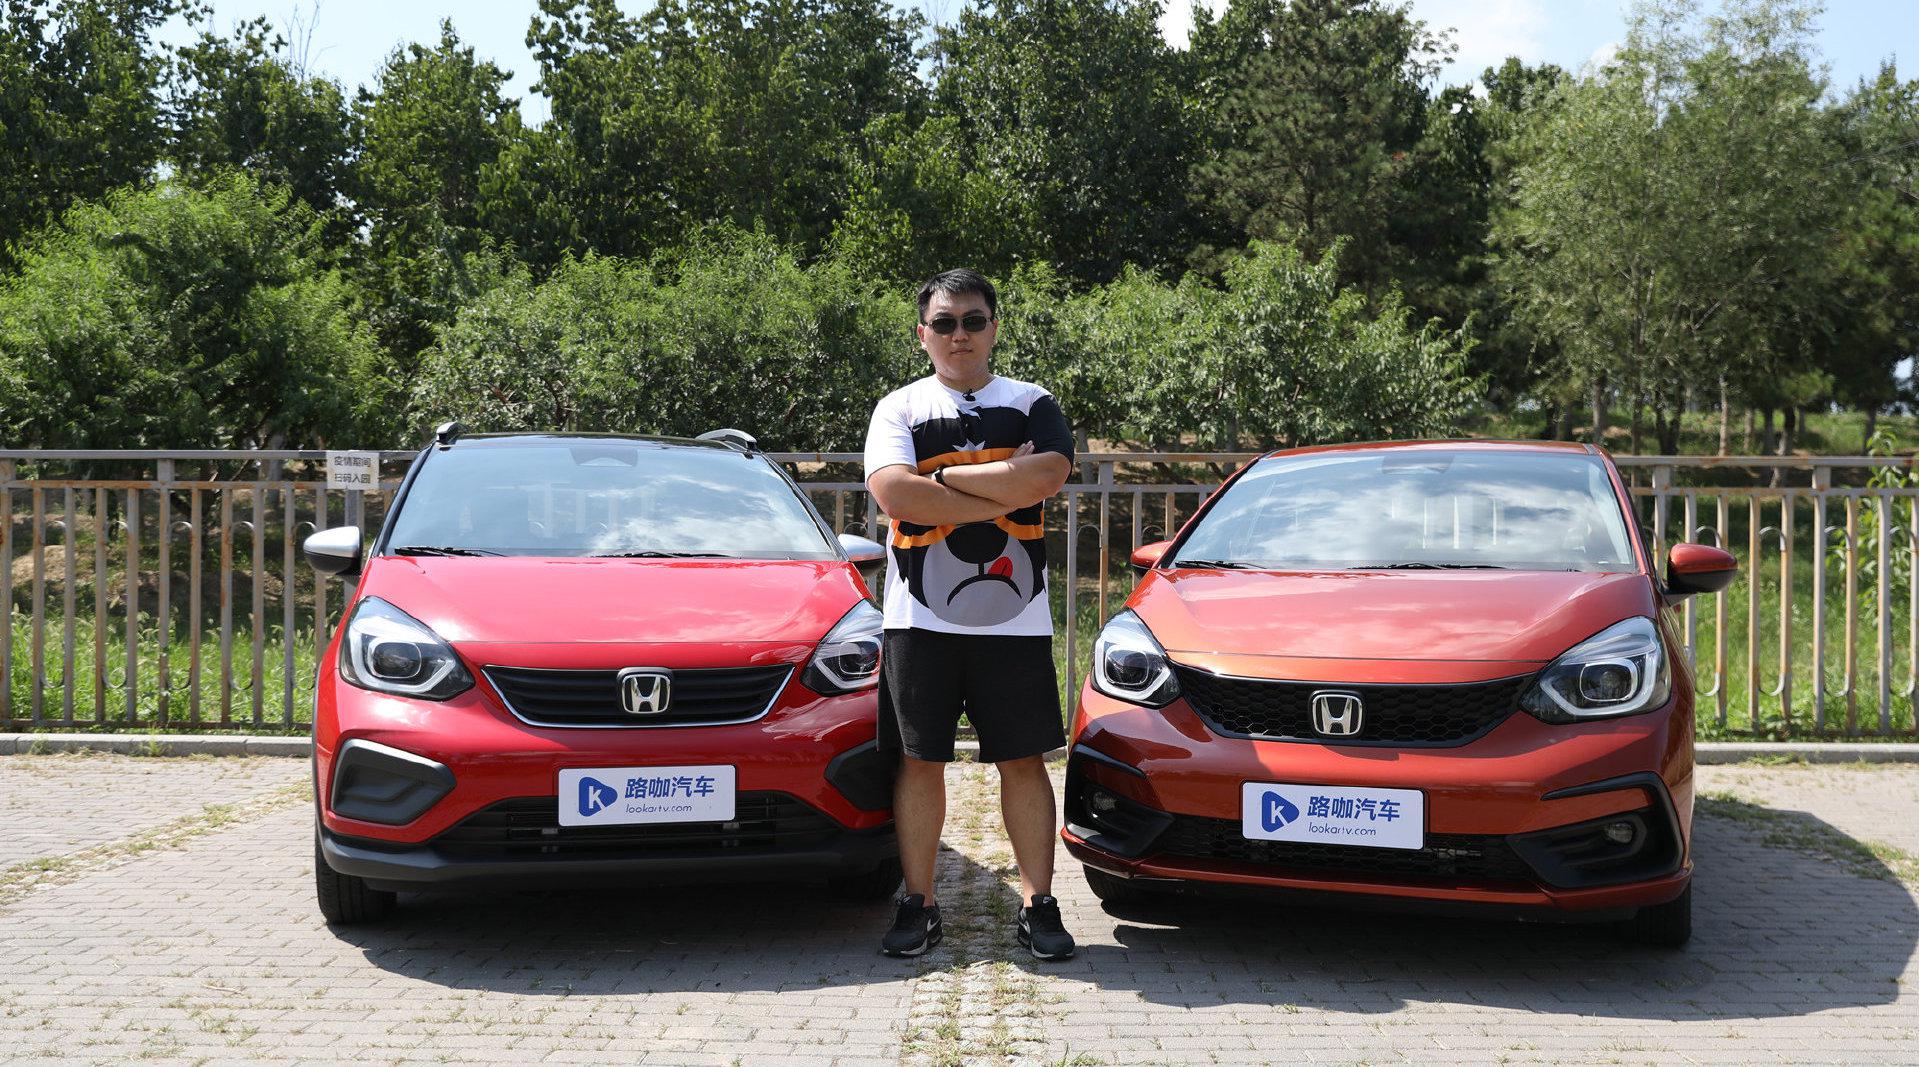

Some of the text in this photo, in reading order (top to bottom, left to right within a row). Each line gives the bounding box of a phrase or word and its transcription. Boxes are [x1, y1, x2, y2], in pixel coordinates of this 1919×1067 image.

[624, 776, 715, 799] 路咖汽车
[1307, 796, 1401, 822] 路咖汽车
[1308, 822, 1377, 836] lookartv.com
